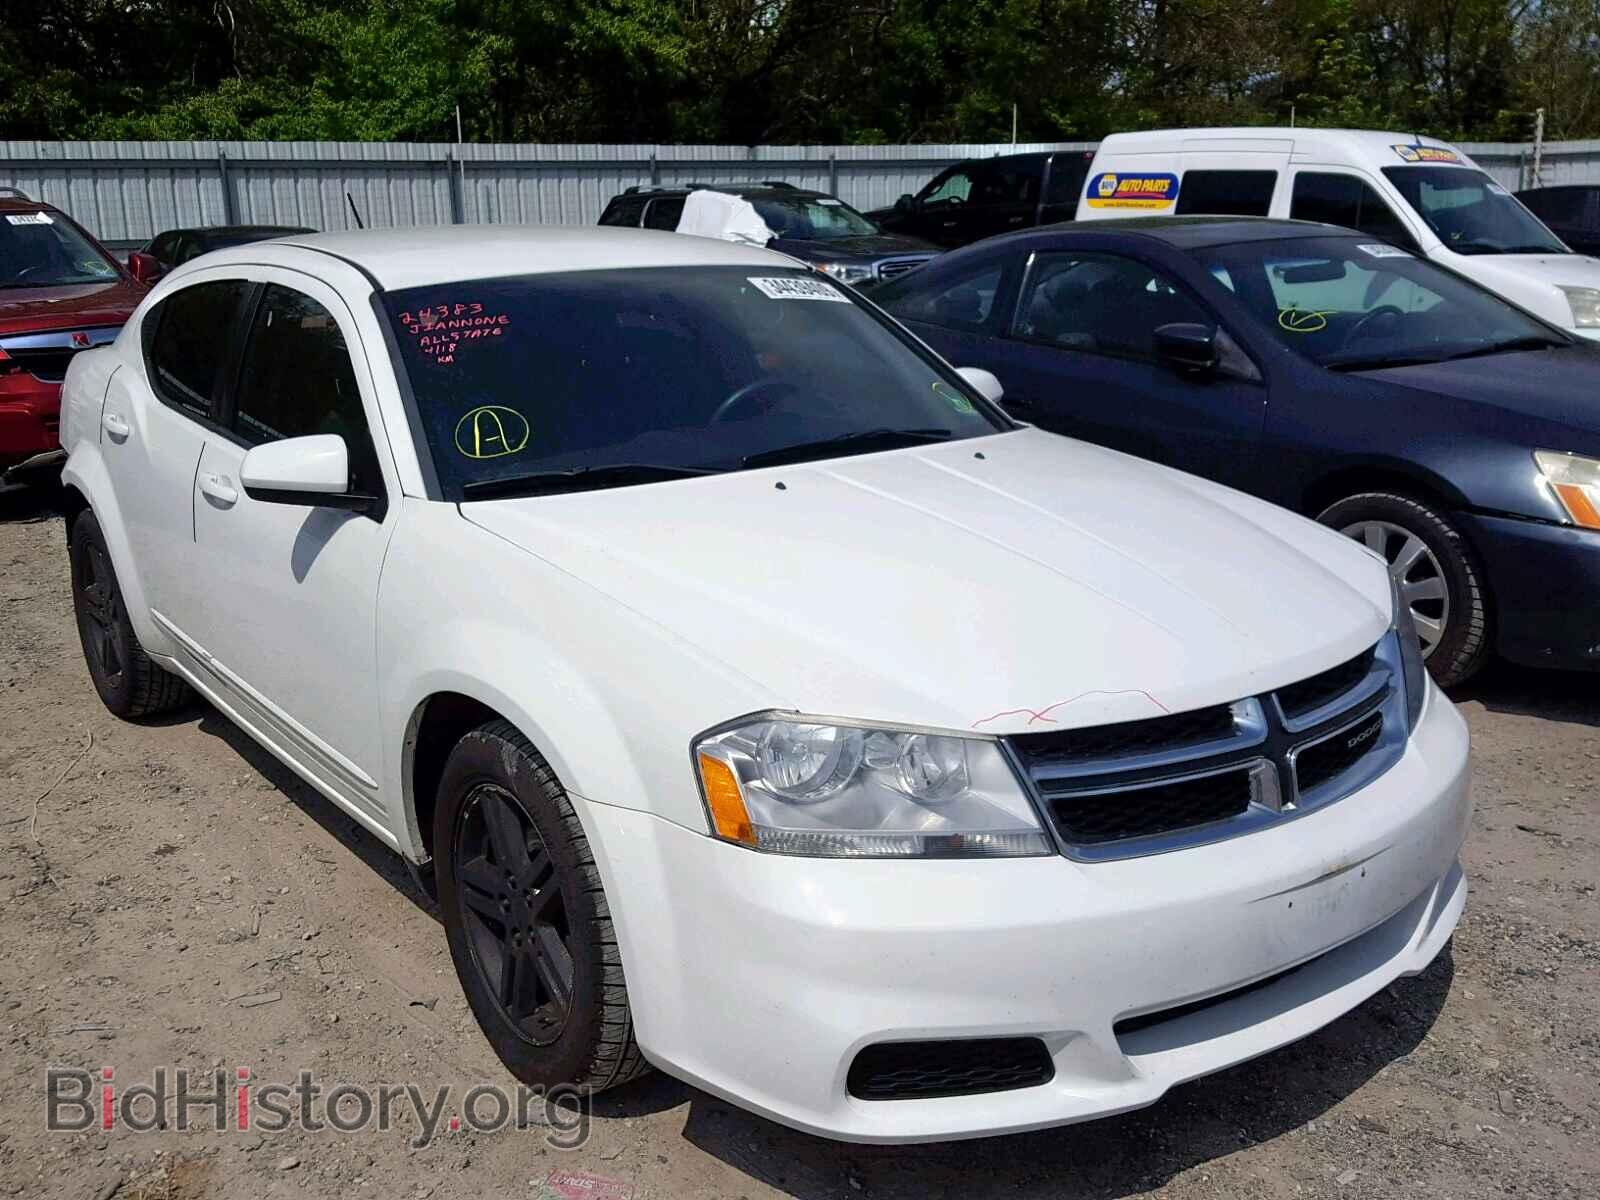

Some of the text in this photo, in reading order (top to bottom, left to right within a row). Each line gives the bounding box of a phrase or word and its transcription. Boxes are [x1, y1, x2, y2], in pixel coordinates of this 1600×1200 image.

[1117, 179, 1141, 192] AUTO
[1141, 179, 1170, 192] PARTS
[420, 328, 503, 346] ALLSTATE
